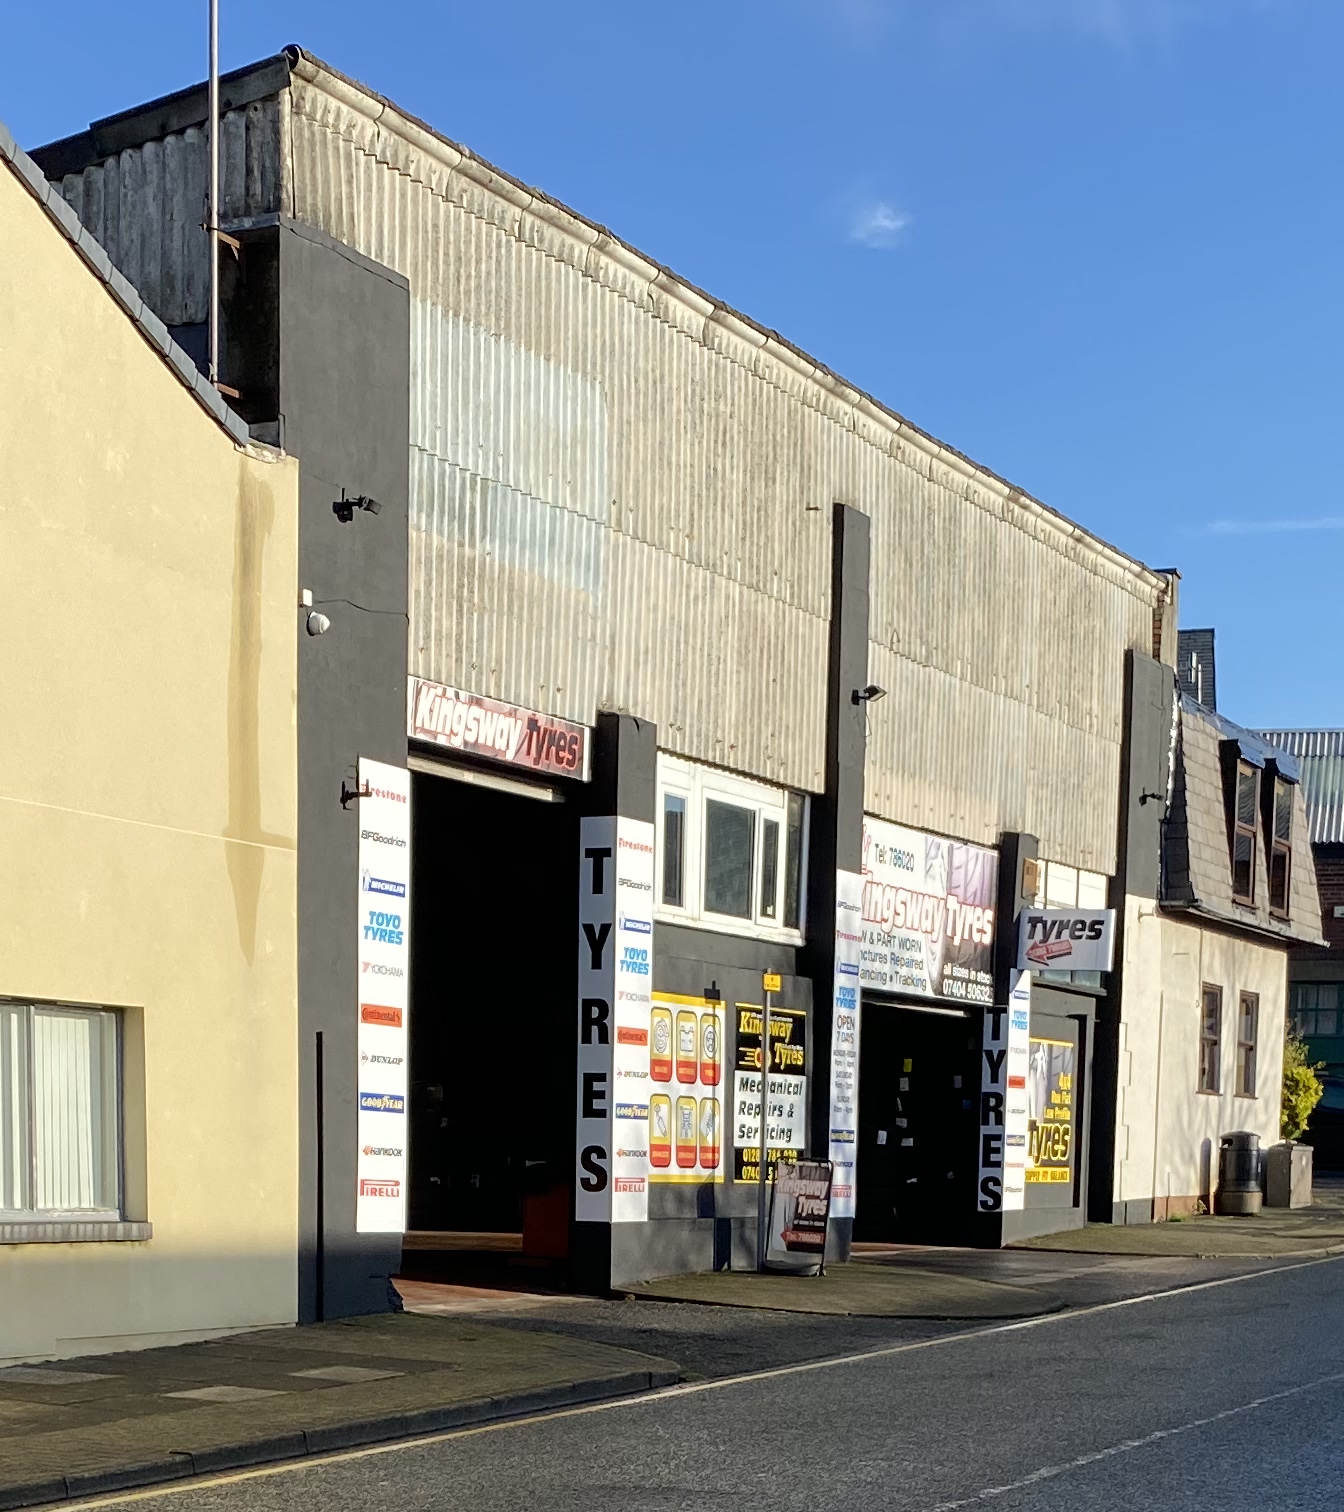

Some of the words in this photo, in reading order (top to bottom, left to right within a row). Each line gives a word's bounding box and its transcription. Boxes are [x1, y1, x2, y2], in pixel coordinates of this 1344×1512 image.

[415, 684, 523, 760] Kingsway
[527, 713, 580, 770] Tyres
[361, 830, 406, 848] BFGoodrich
[371, 880, 405, 895] MICHELIN
[862, 869, 946, 943] ingsway
[946, 893, 993, 946] Tyres
[369, 911, 401, 930] TOYO
[1027, 916, 1105, 944] Tyres
[363, 925, 404, 945] TYRES
[876, 932, 896, 948] PART
[898, 936, 922, 953] WORN
[624, 947, 648, 961] TOYO
[889, 952, 924, 970] Repaired
[620, 959, 649, 975] TYRES
[860, 969, 887, 985] ancing
[895, 971, 927, 991] Tracking
[943, 978, 966, 997] 07404
[580, 847, 612, 1192] TYRES
[837, 1014, 855, 1031] OPEN
[841, 1031, 854, 1044] DAYS
[370, 1055, 404, 1065] DUNLOP
[774, 1042, 804, 1070] Tyres
[738, 1077, 803, 1096] Mecanical
[738, 1100, 784, 1118] Repirs
[787, 1103, 794, 1118] &
[980, 1006, 1007, 1211] TYRES
[738, 1124, 793, 1143] Sericing
[1028, 1119, 1071, 1167] Tyres
[777, 1178, 829, 1200] Kingsway
[797, 1195, 827, 1217] Tyres
